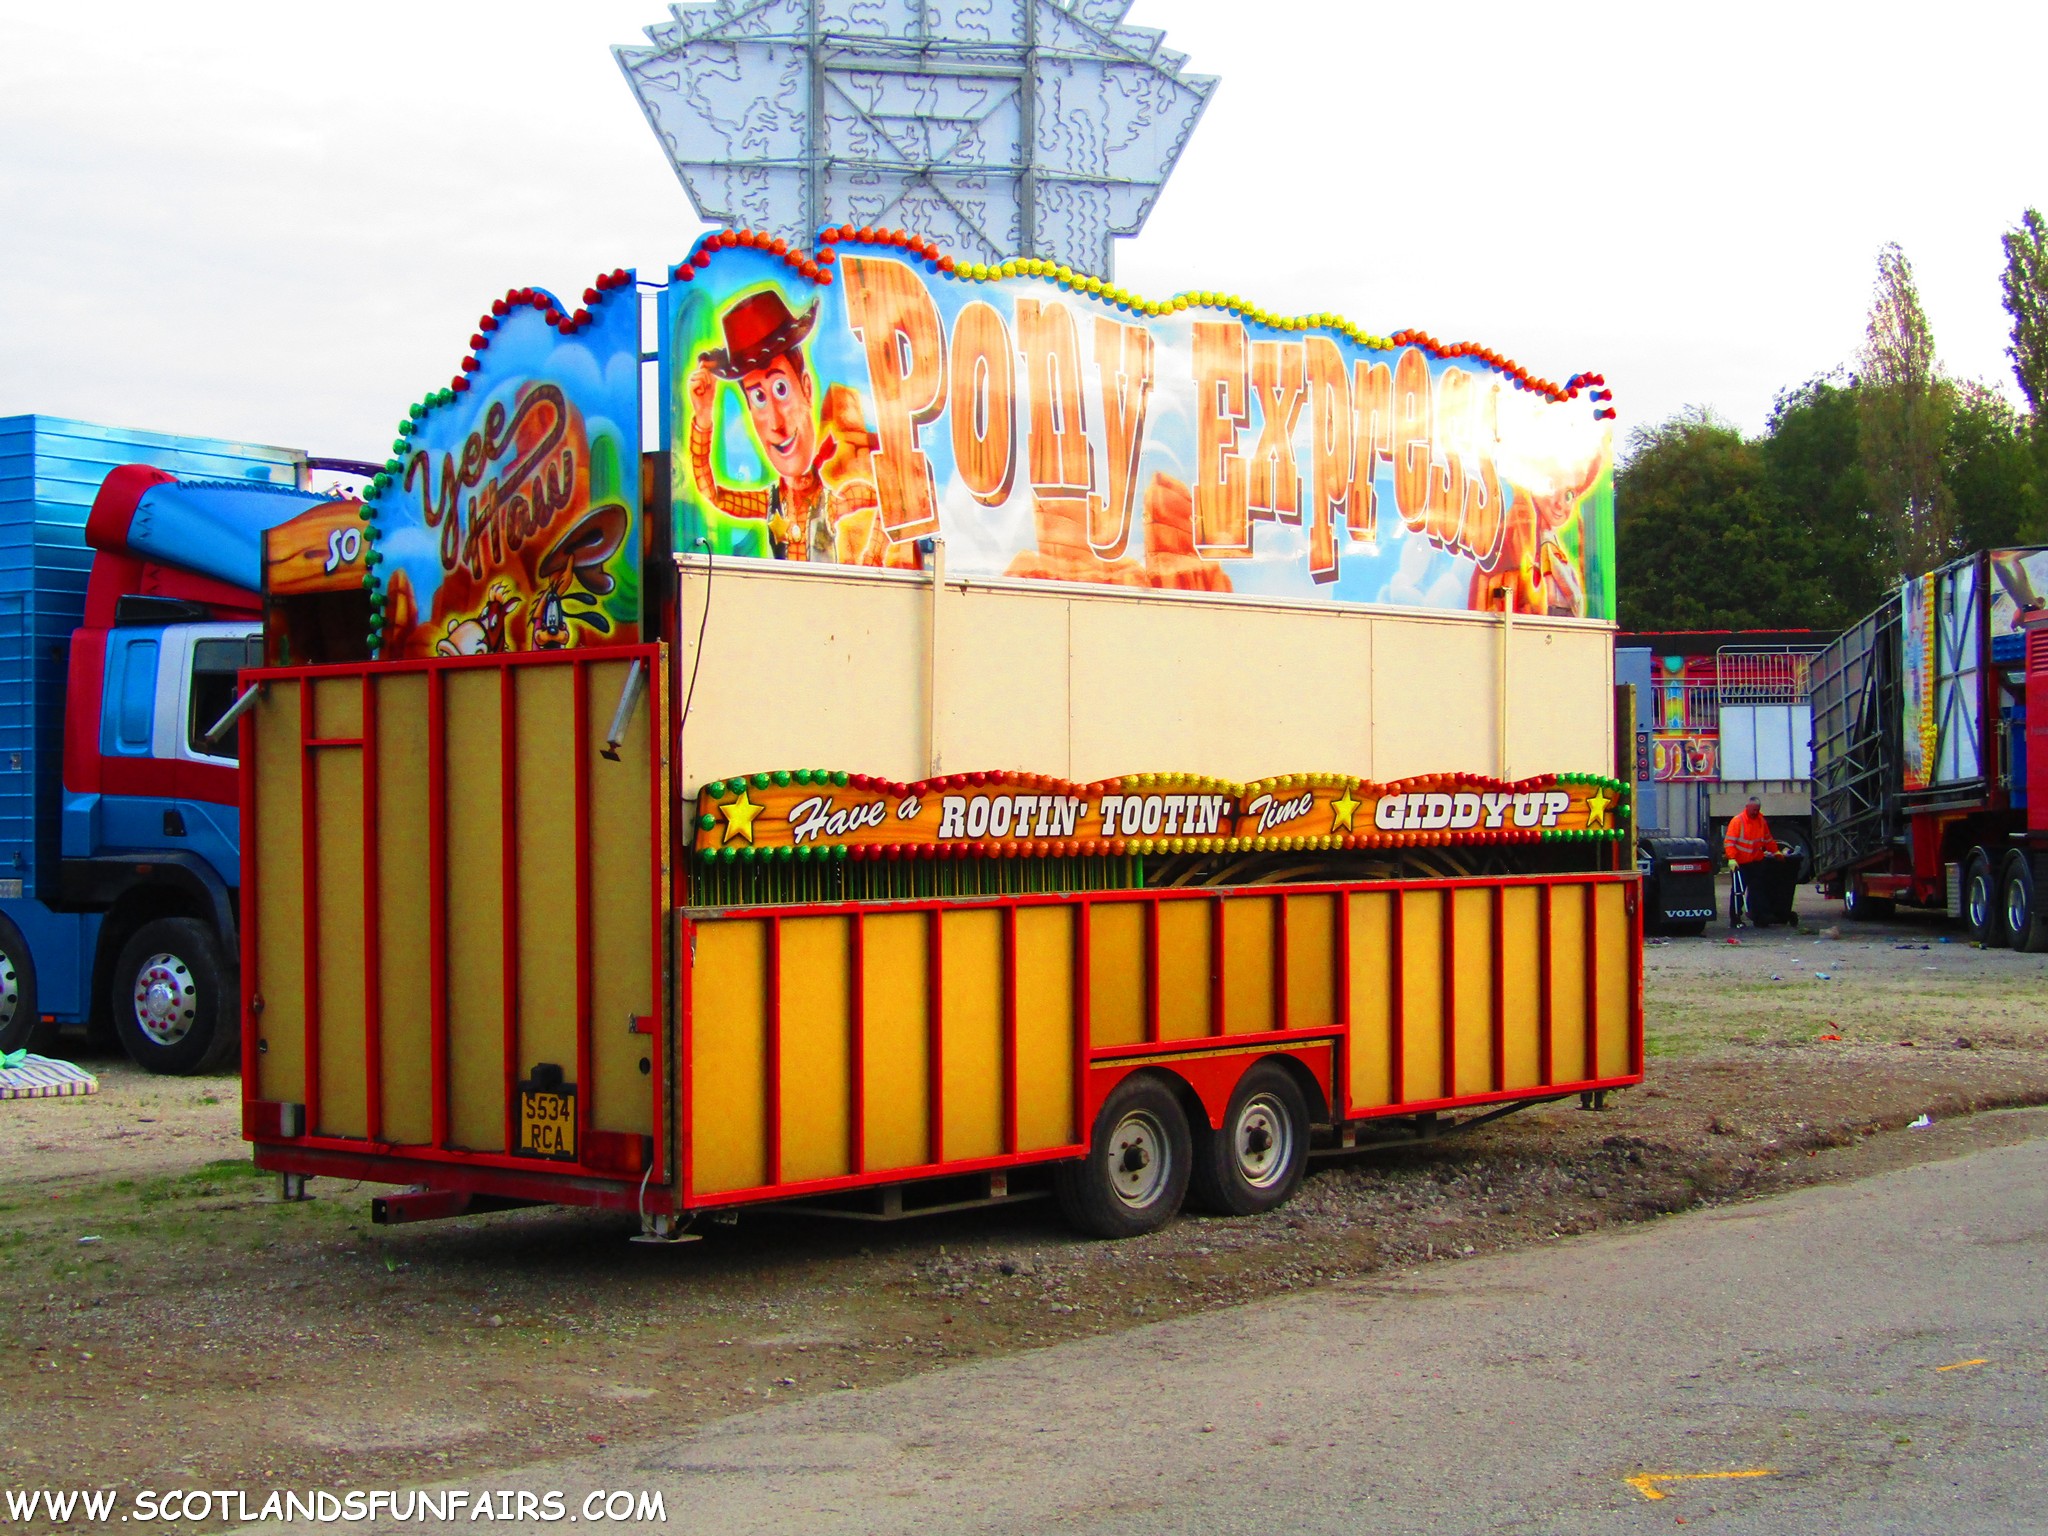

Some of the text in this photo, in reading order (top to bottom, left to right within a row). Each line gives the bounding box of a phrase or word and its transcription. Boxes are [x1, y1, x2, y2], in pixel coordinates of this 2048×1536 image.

[839, 253, 1154, 563] Pony
[404, 394, 530, 571] Yee
[462, 449, 574, 580] Haw
[789, 792, 1569, 844] Have a ROOTIN' TOOTIN' Time GIDDYUP
[1665, 908, 1713, 918] VOLVO
[526, 1096, 570, 1121] S534
[531, 1124, 564, 1150] RCA
